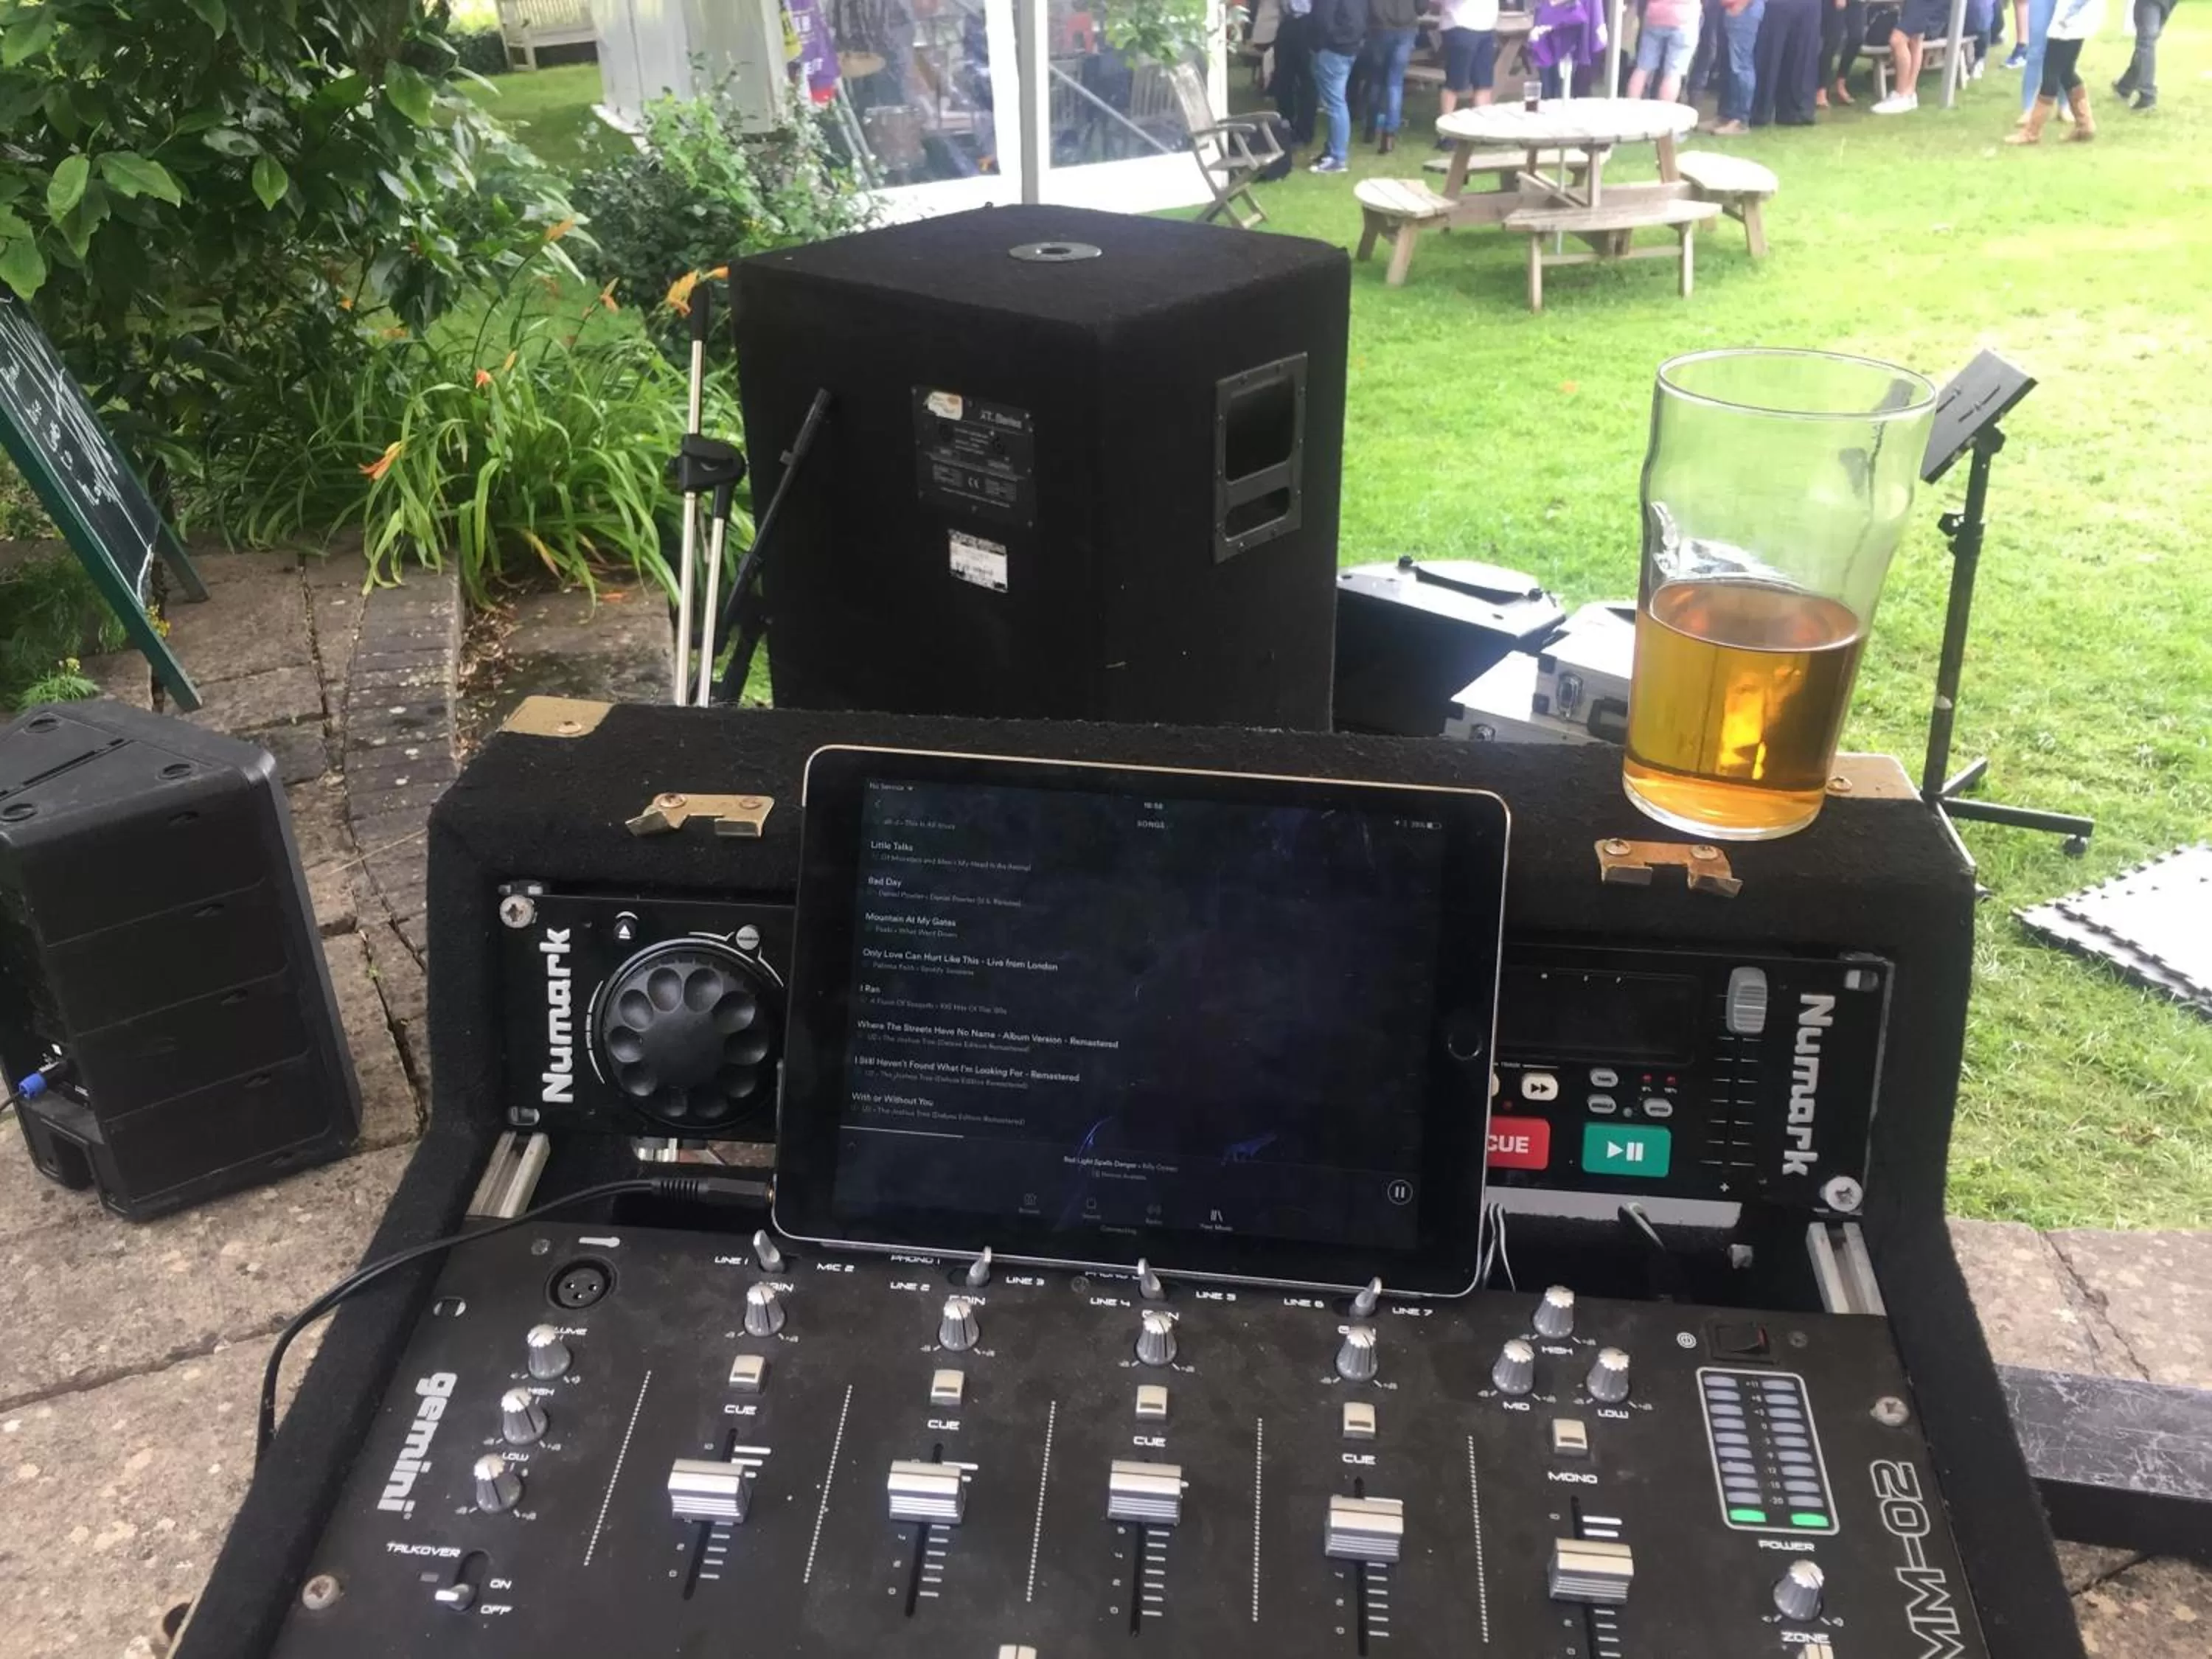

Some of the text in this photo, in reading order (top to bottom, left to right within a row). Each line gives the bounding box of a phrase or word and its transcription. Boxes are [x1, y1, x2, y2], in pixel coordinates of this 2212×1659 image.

[870, 841, 913, 852] Little Talks
[868, 876, 902, 888] Bad Day
[865, 913, 956, 927] Mountain At My Gates
[863, 947, 1058, 972] Only Love Can Hurt Like This Live from London
[864, 984, 880, 994] Ran
[539, 928, 574, 1103] Numark
[858, 1020, 1119, 1049] Where The Streets Have No Name Album Version Remastered
[859, 1055, 875, 1065] Still
[876, 1058, 908, 1068] Haven't
[909, 1060, 935, 1071] Found
[936, 1062, 959, 1072] What
[961, 1063, 973, 1073] I'm
[975, 1065, 1008, 1078] Looking
[1009, 1068, 1024, 1077] For
[1030, 1070, 1080, 1082] Remastered
[1782, 993, 1836, 1176] Numark
[852, 1092, 934, 1107] With or Without You
[1488, 1135, 1529, 1154] CUE
[1114, 1160, 1136, 1170] Danger
[714, 1256, 748, 1265] LINE 1
[891, 1254, 933, 1264] PHONO
[816, 1262, 855, 1272] MIC 2
[890, 1281, 918, 1290] LINE
[1006, 1276, 1032, 1285] LINE
[1195, 1290, 1223, 1300] LINE
[1090, 1297, 1130, 1307] LINE 4
[1284, 1298, 1324, 1309] LINE 6
[1392, 1307, 1420, 1316] LINE
[1541, 1346, 1573, 1355] HIGH
[724, 1404, 757, 1416] CUE
[1502, 1401, 1531, 1411] MID
[1597, 1409, 1629, 1419] LOW
[927, 1419, 960, 1430] CUE
[1133, 1436, 1166, 1447] CUE
[502, 1452, 529, 1461] LOW
[1341, 1453, 1377, 1465] CUE
[1548, 1472, 1598, 1484] MONO
[386, 1541, 461, 1557] TALKOVER
[1757, 1539, 1815, 1552] POWER
[490, 1579, 512, 1590] ON
[480, 1604, 514, 1615] OFF
[1781, 1630, 1831, 1645] ZONE
